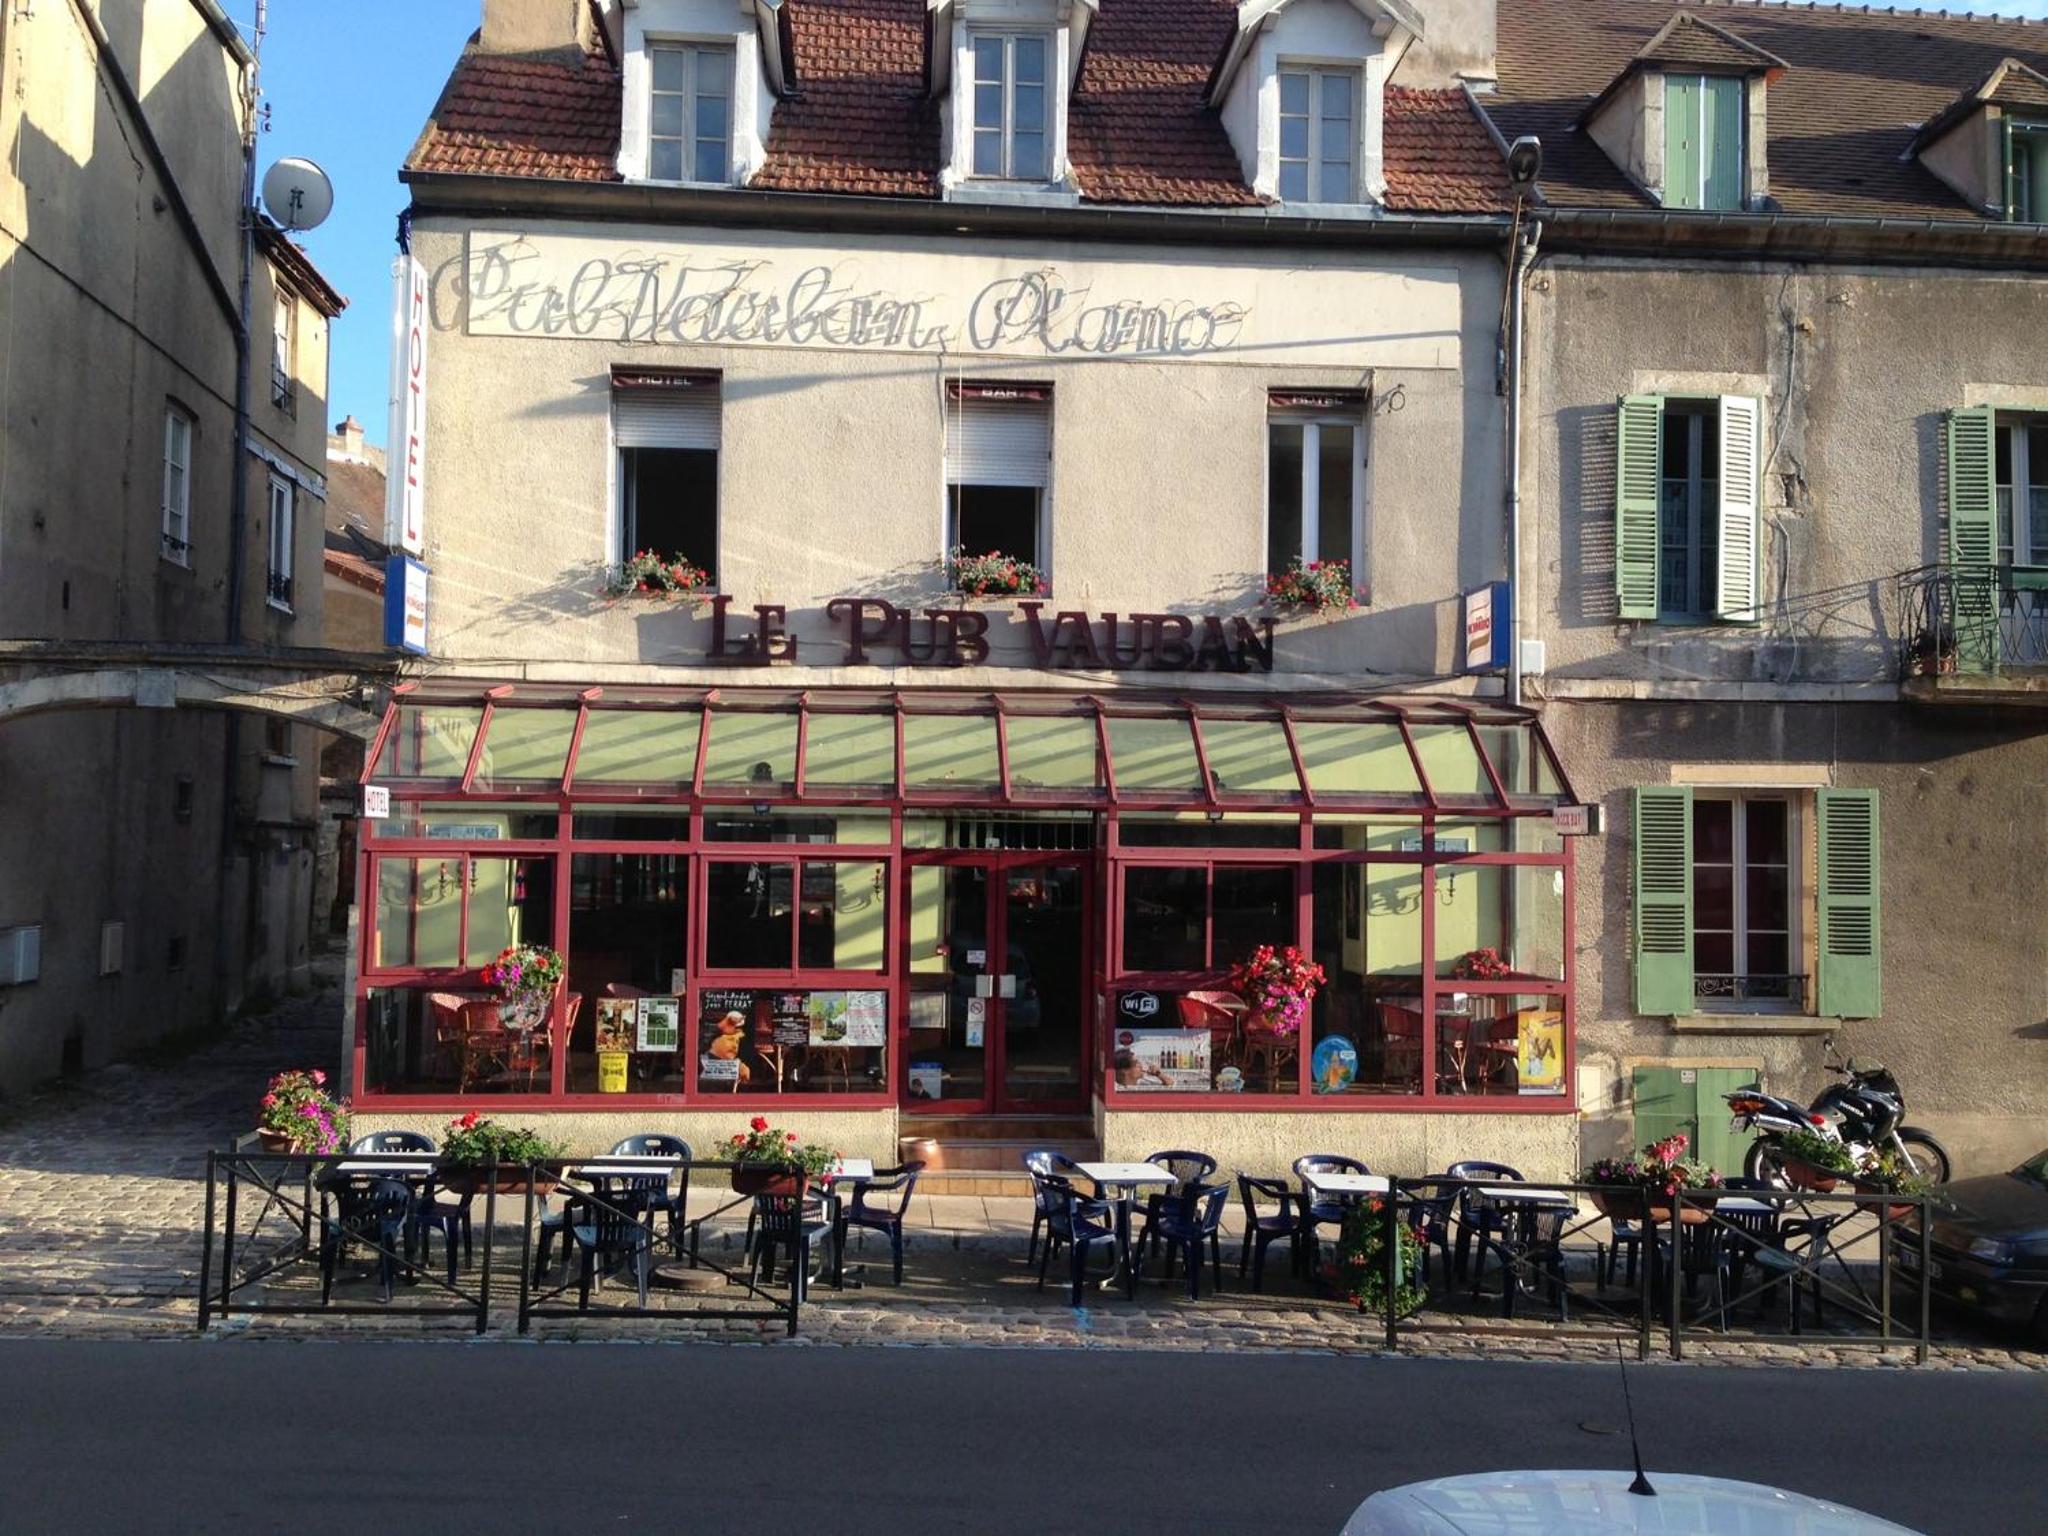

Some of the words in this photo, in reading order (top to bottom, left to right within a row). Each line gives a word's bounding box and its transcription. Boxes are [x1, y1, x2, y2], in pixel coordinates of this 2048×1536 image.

[407, 271, 424, 541] HOTEL
[705, 595, 797, 661] LE
[827, 597, 989, 667] PUB
[1018, 601, 1280, 673] VAUBAN
[367, 791, 388, 813] HOTEL
